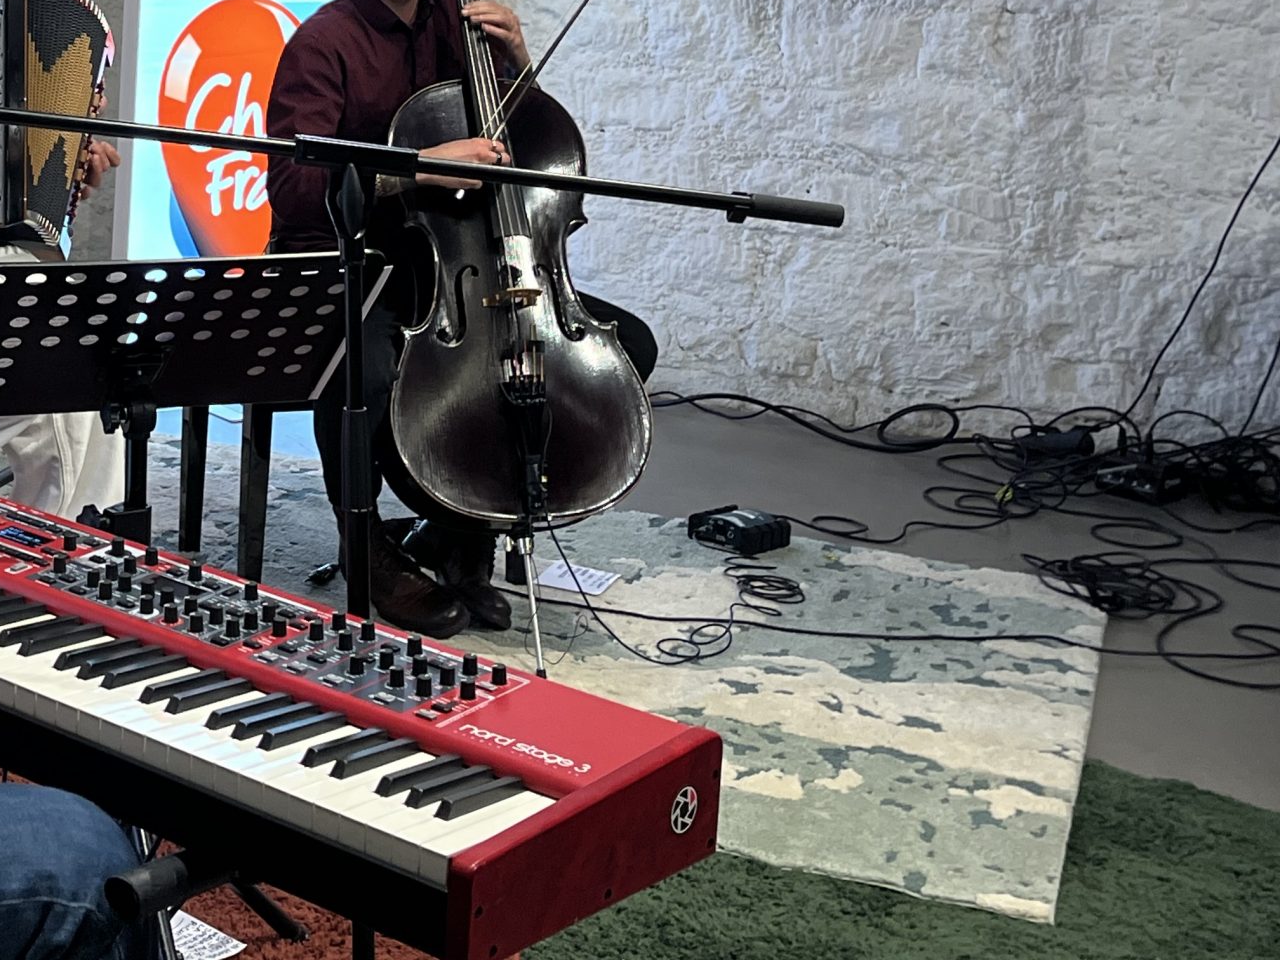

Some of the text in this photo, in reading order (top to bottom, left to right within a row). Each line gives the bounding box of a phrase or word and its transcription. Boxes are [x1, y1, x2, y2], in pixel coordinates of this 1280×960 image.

[458, 724, 592, 773] nord stage 3
